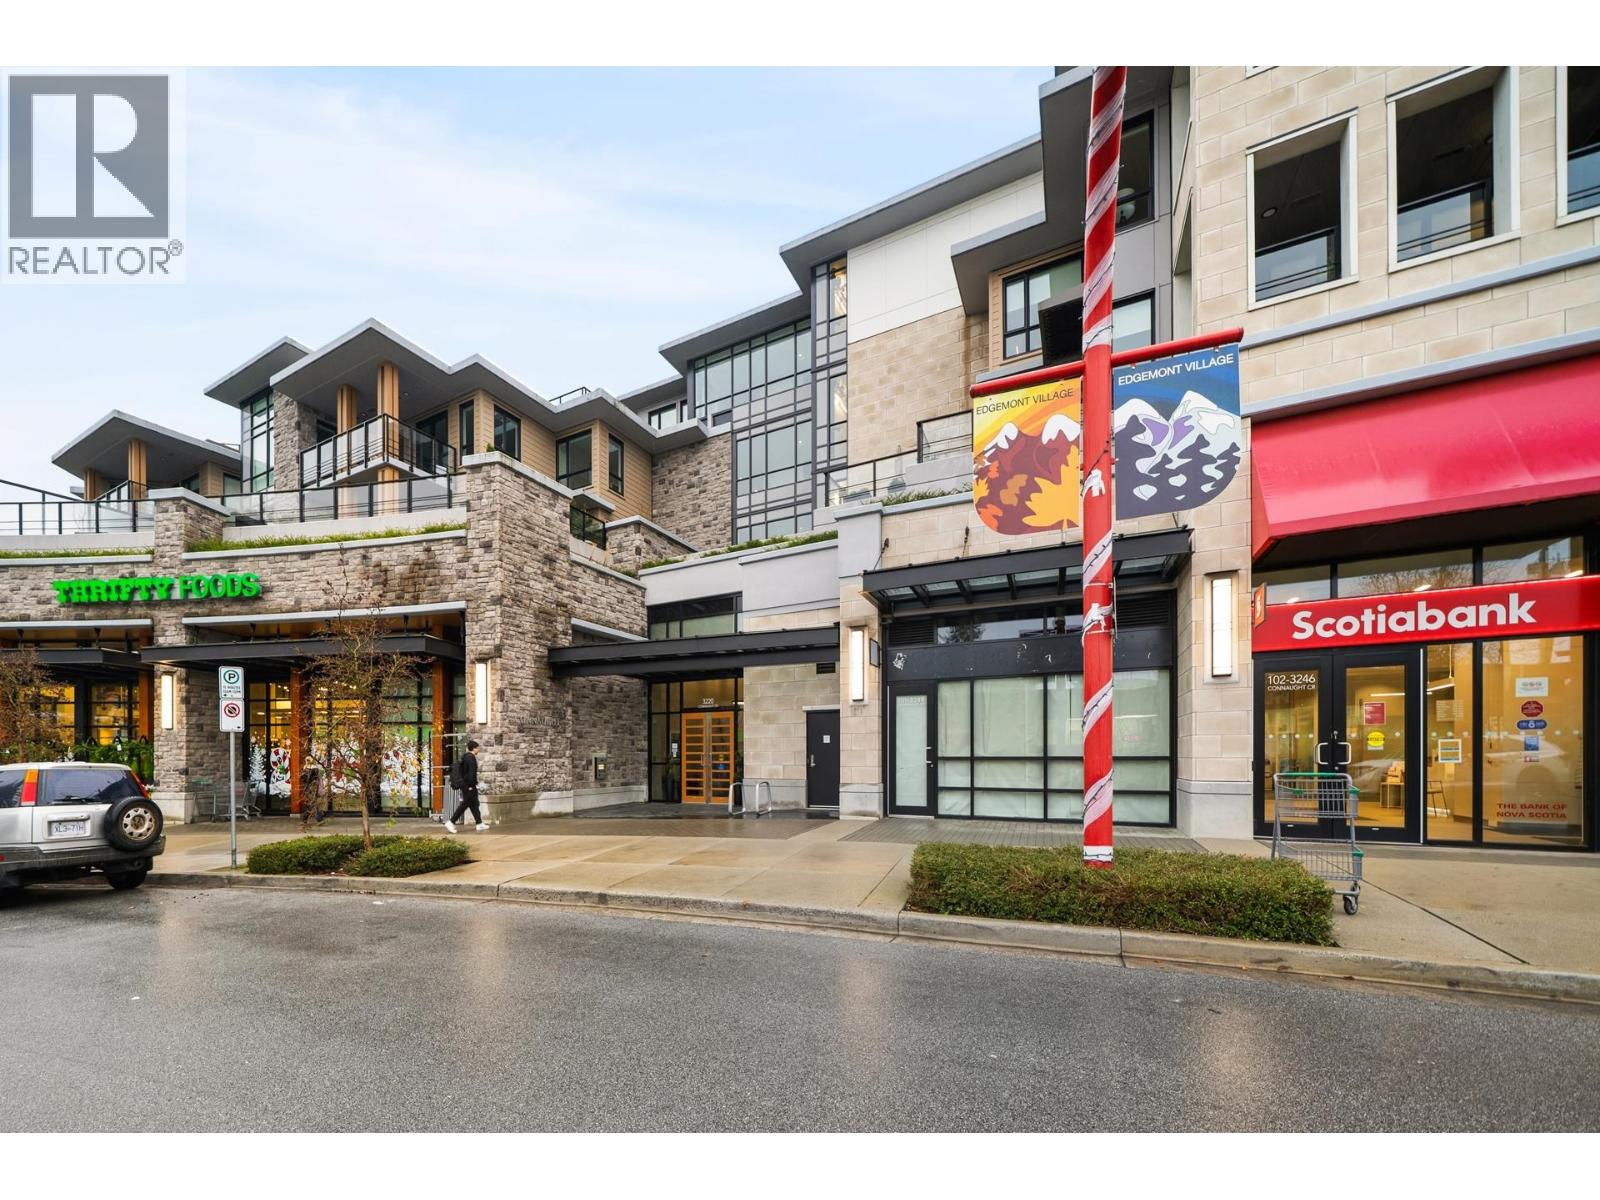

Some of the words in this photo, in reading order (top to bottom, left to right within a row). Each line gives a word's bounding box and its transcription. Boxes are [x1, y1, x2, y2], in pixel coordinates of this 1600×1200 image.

[1118, 363, 1183, 387] EDGEMONT
[1184, 353, 1234, 372] VILLAGE
[976, 396, 1030, 415] EDGEMONT
[1032, 387, 1074, 405] VILLAGE
[52, 577, 175, 603] THRIFTY
[179, 573, 262, 599] FOODS
[1291, 592, 1537, 640] Scotiabank
[1267, 673, 1316, 685] 102-3246
[1528, 811, 1568, 819] SCOTIA
